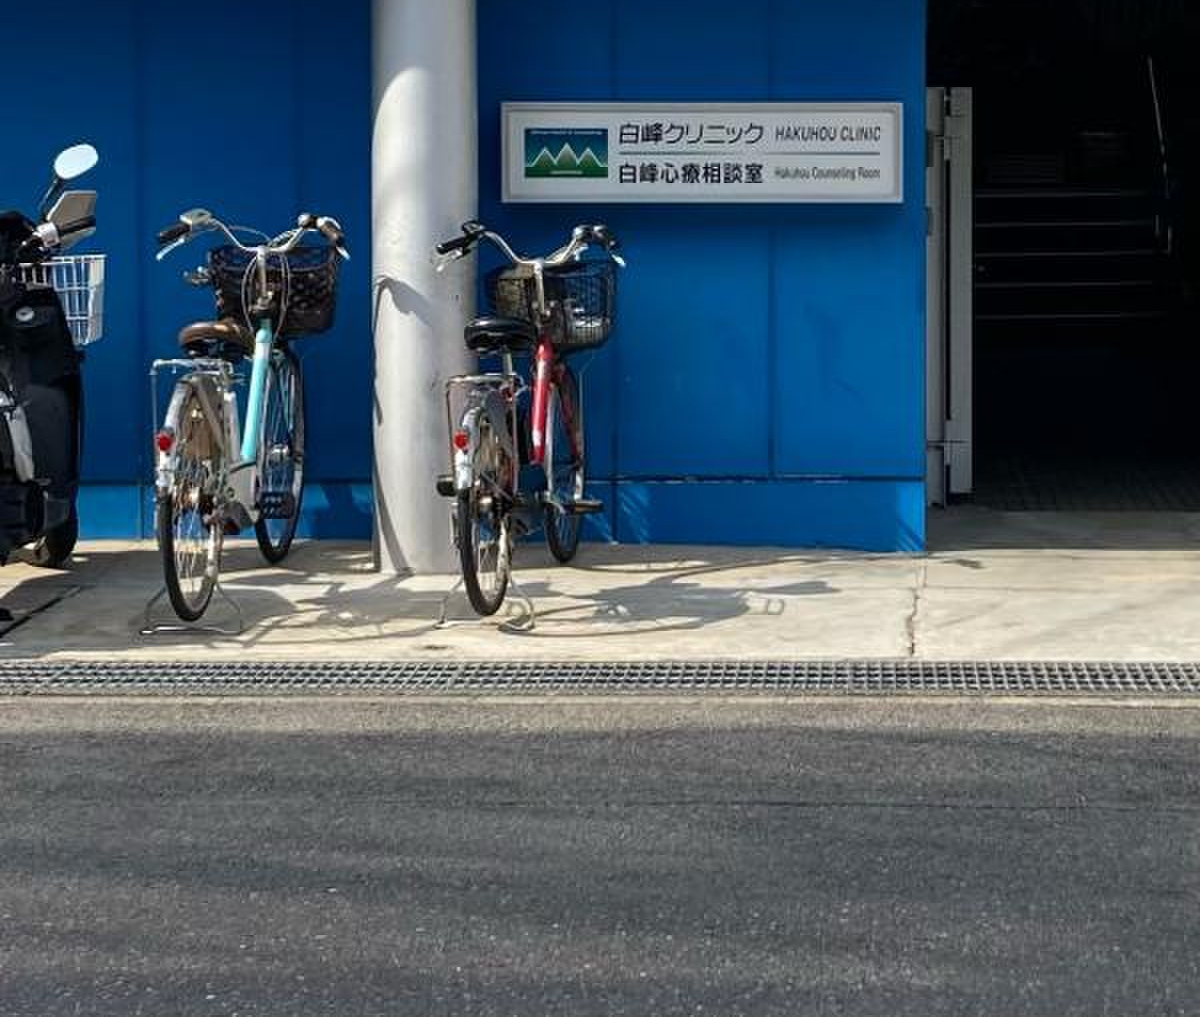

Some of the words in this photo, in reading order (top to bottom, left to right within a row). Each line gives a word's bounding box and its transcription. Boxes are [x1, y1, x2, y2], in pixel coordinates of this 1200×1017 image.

[619, 122, 764, 144] 白峰クリニック
[775, 125, 837, 142] HAKUHOU
[840, 125, 881, 142] CLINIC
[619, 162, 763, 184] 白峰心療相談室
